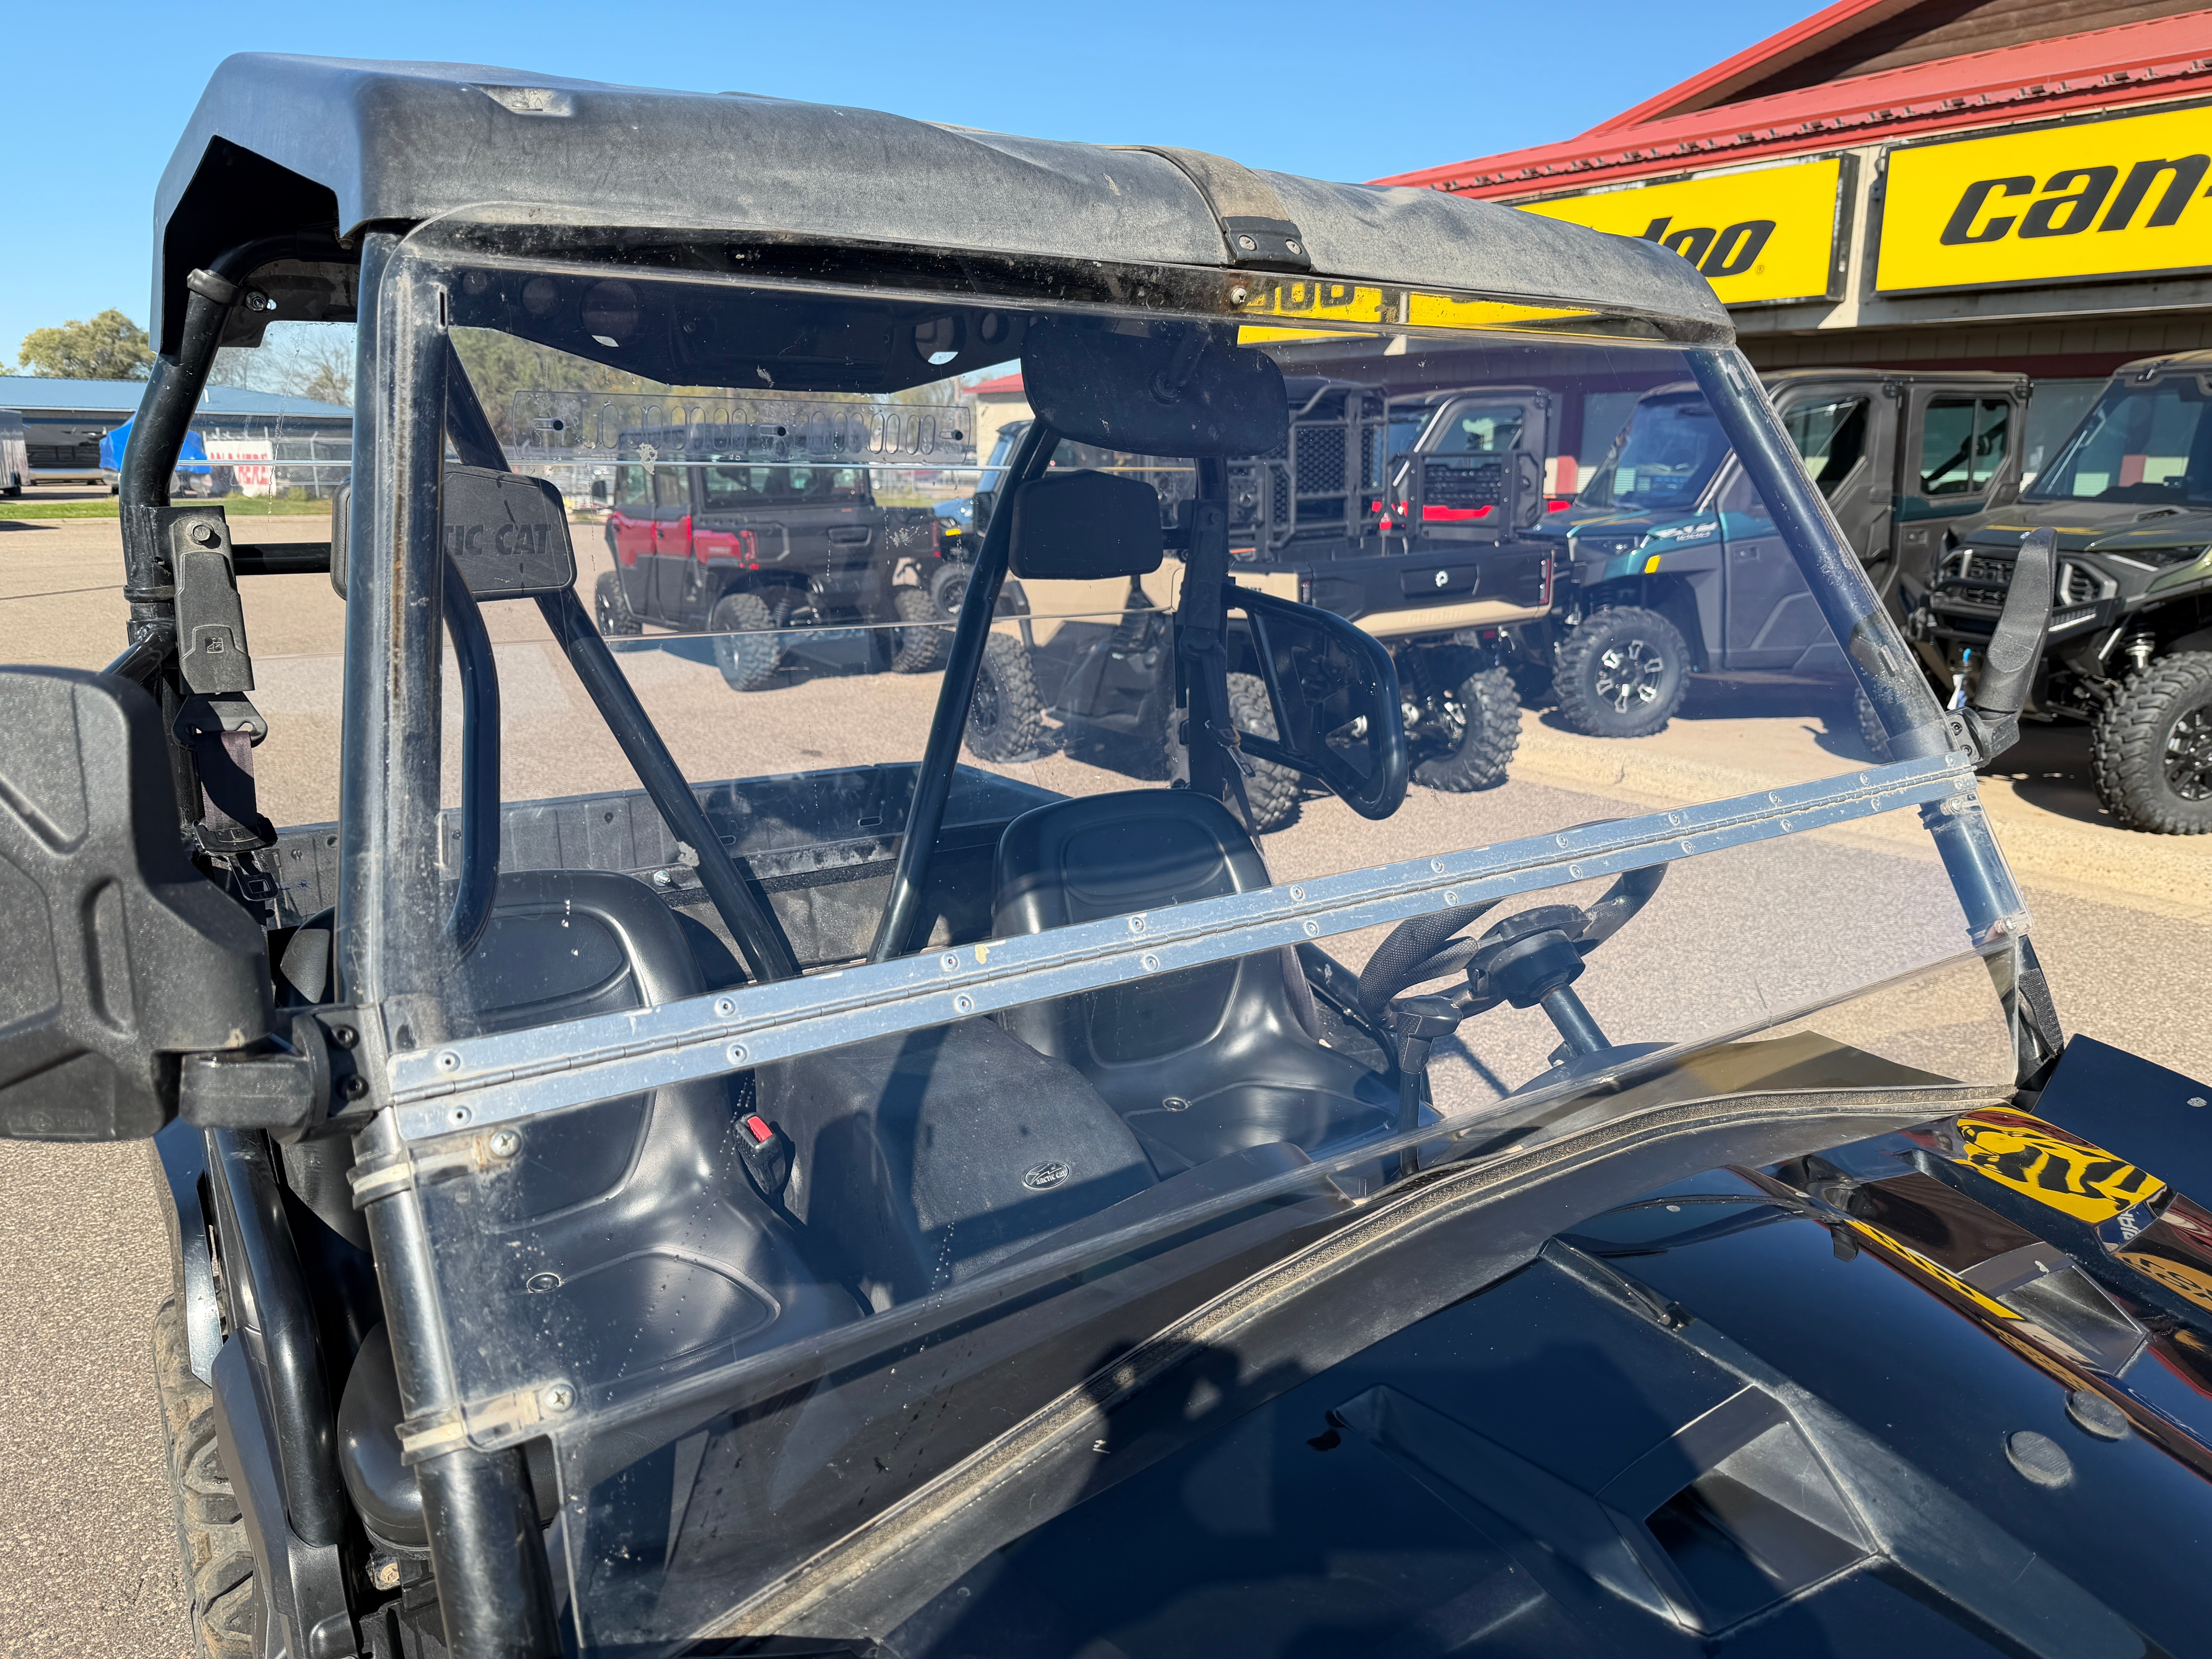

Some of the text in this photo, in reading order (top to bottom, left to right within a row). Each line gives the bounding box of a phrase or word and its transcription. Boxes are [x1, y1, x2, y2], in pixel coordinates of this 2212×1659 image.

[495, 524, 552, 555] CAT
[1036, 1169, 1067, 1185] ARCTIC CAT
